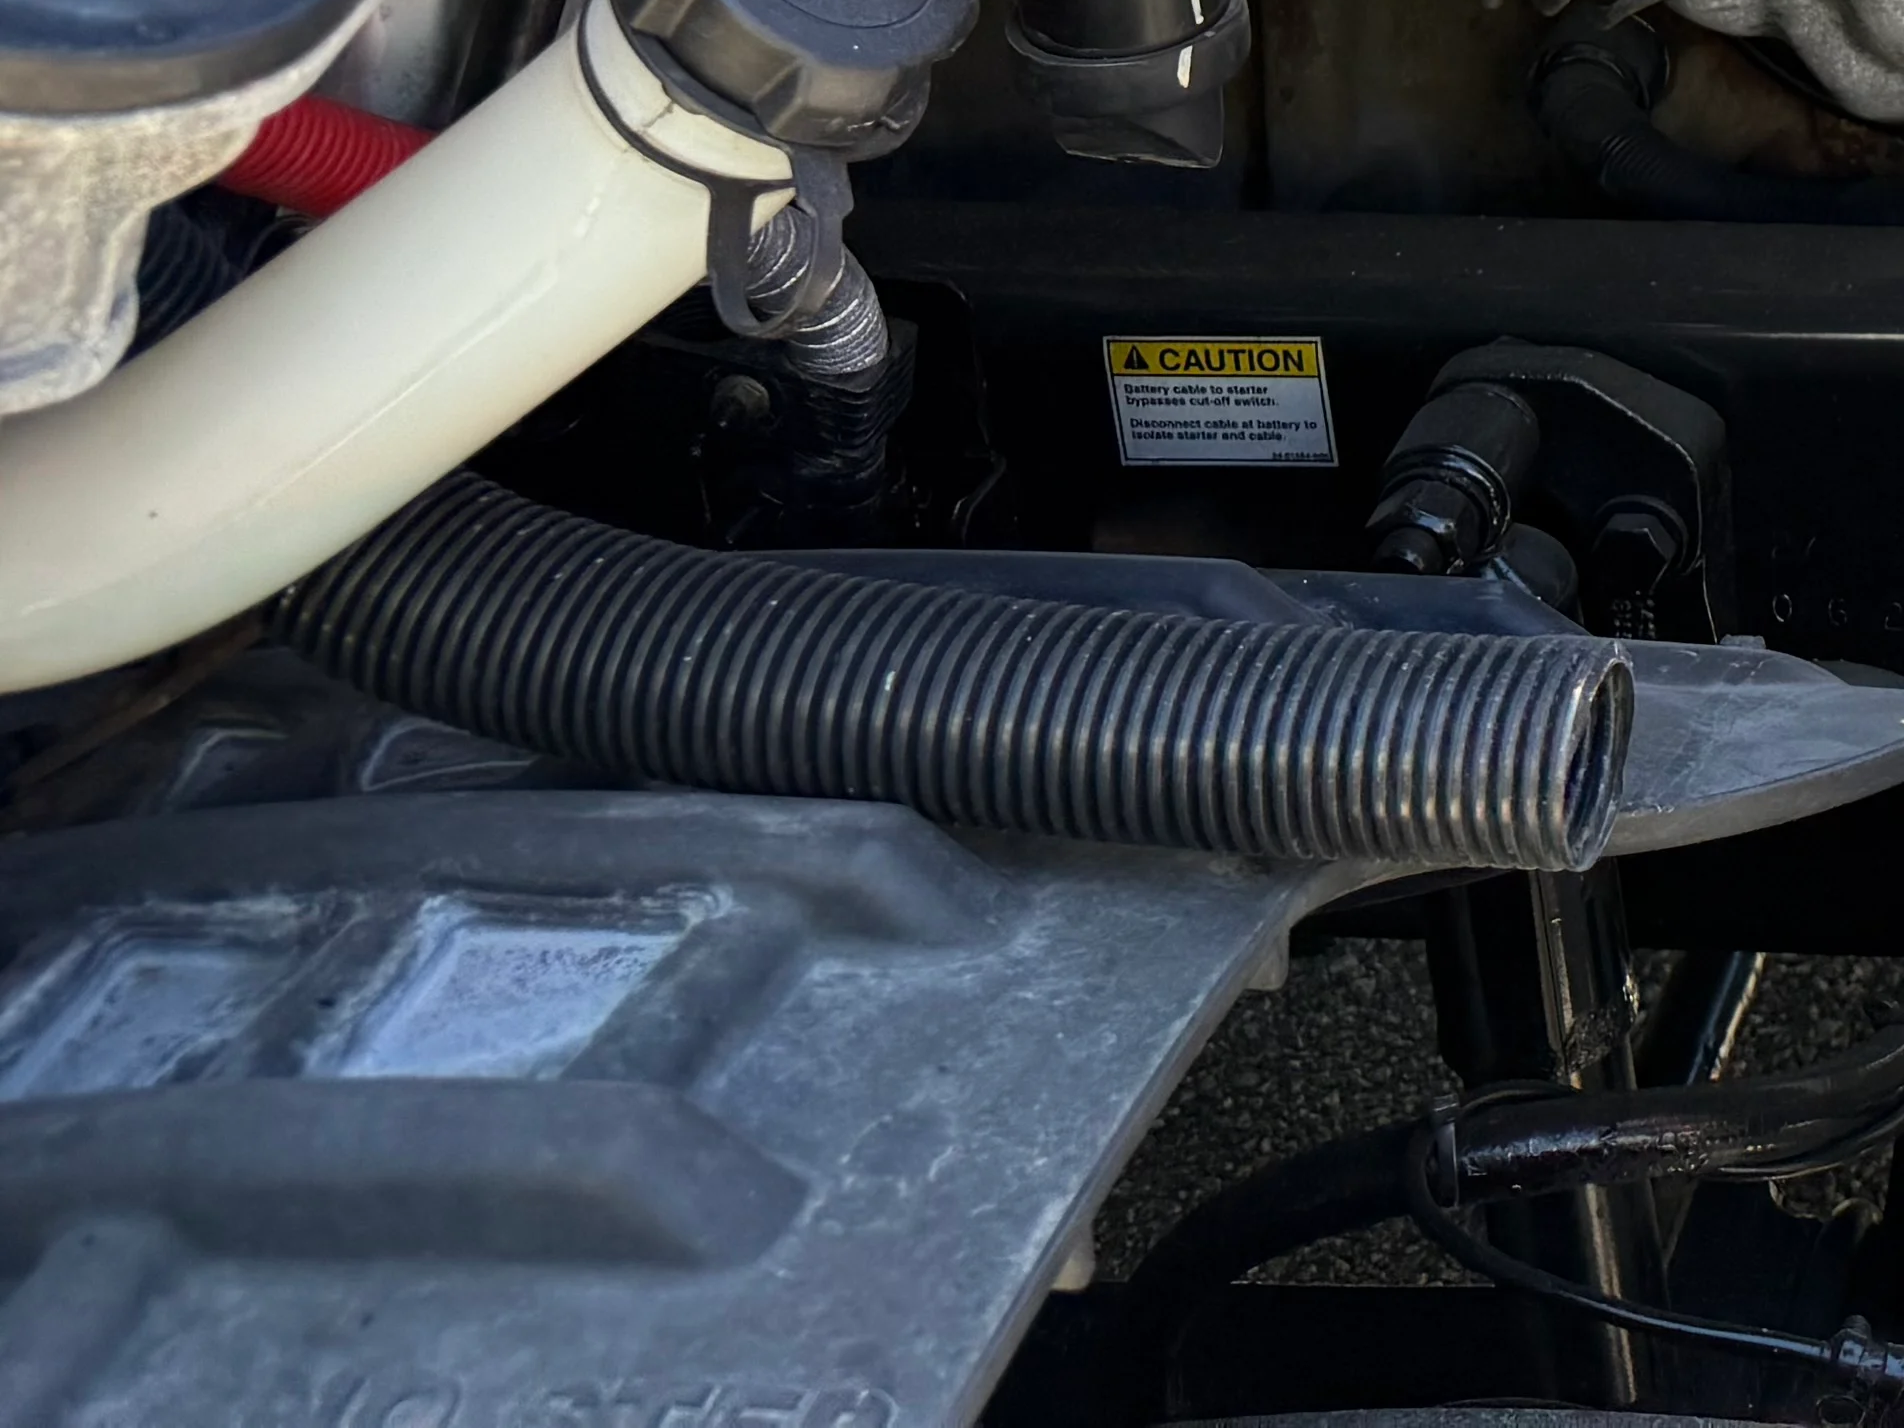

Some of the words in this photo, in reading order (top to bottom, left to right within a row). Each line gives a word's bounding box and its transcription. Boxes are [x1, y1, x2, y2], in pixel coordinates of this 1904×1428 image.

[1159, 348, 1304, 372] CAUTION
[1124, 384, 1169, 395] Battery
[1173, 385, 1207, 394] cable
[1210, 385, 1223, 394] to
[1227, 385, 1268, 394] starter
[1126, 396, 1186, 408] bypasses
[1190, 396, 1230, 406] cut-off
[1235, 397, 1279, 407] switch.
[1130, 419, 1201, 429] Disconnect
[1204, 419, 1238, 429] cable
[1242, 420, 1253, 429] at
[1257, 420, 1300, 431] battery
[1304, 420, 1317, 429] to
[1132, 430, 1173, 440] isolate
[1177, 431, 1218, 440] starter
[1222, 431, 1245, 441] and
